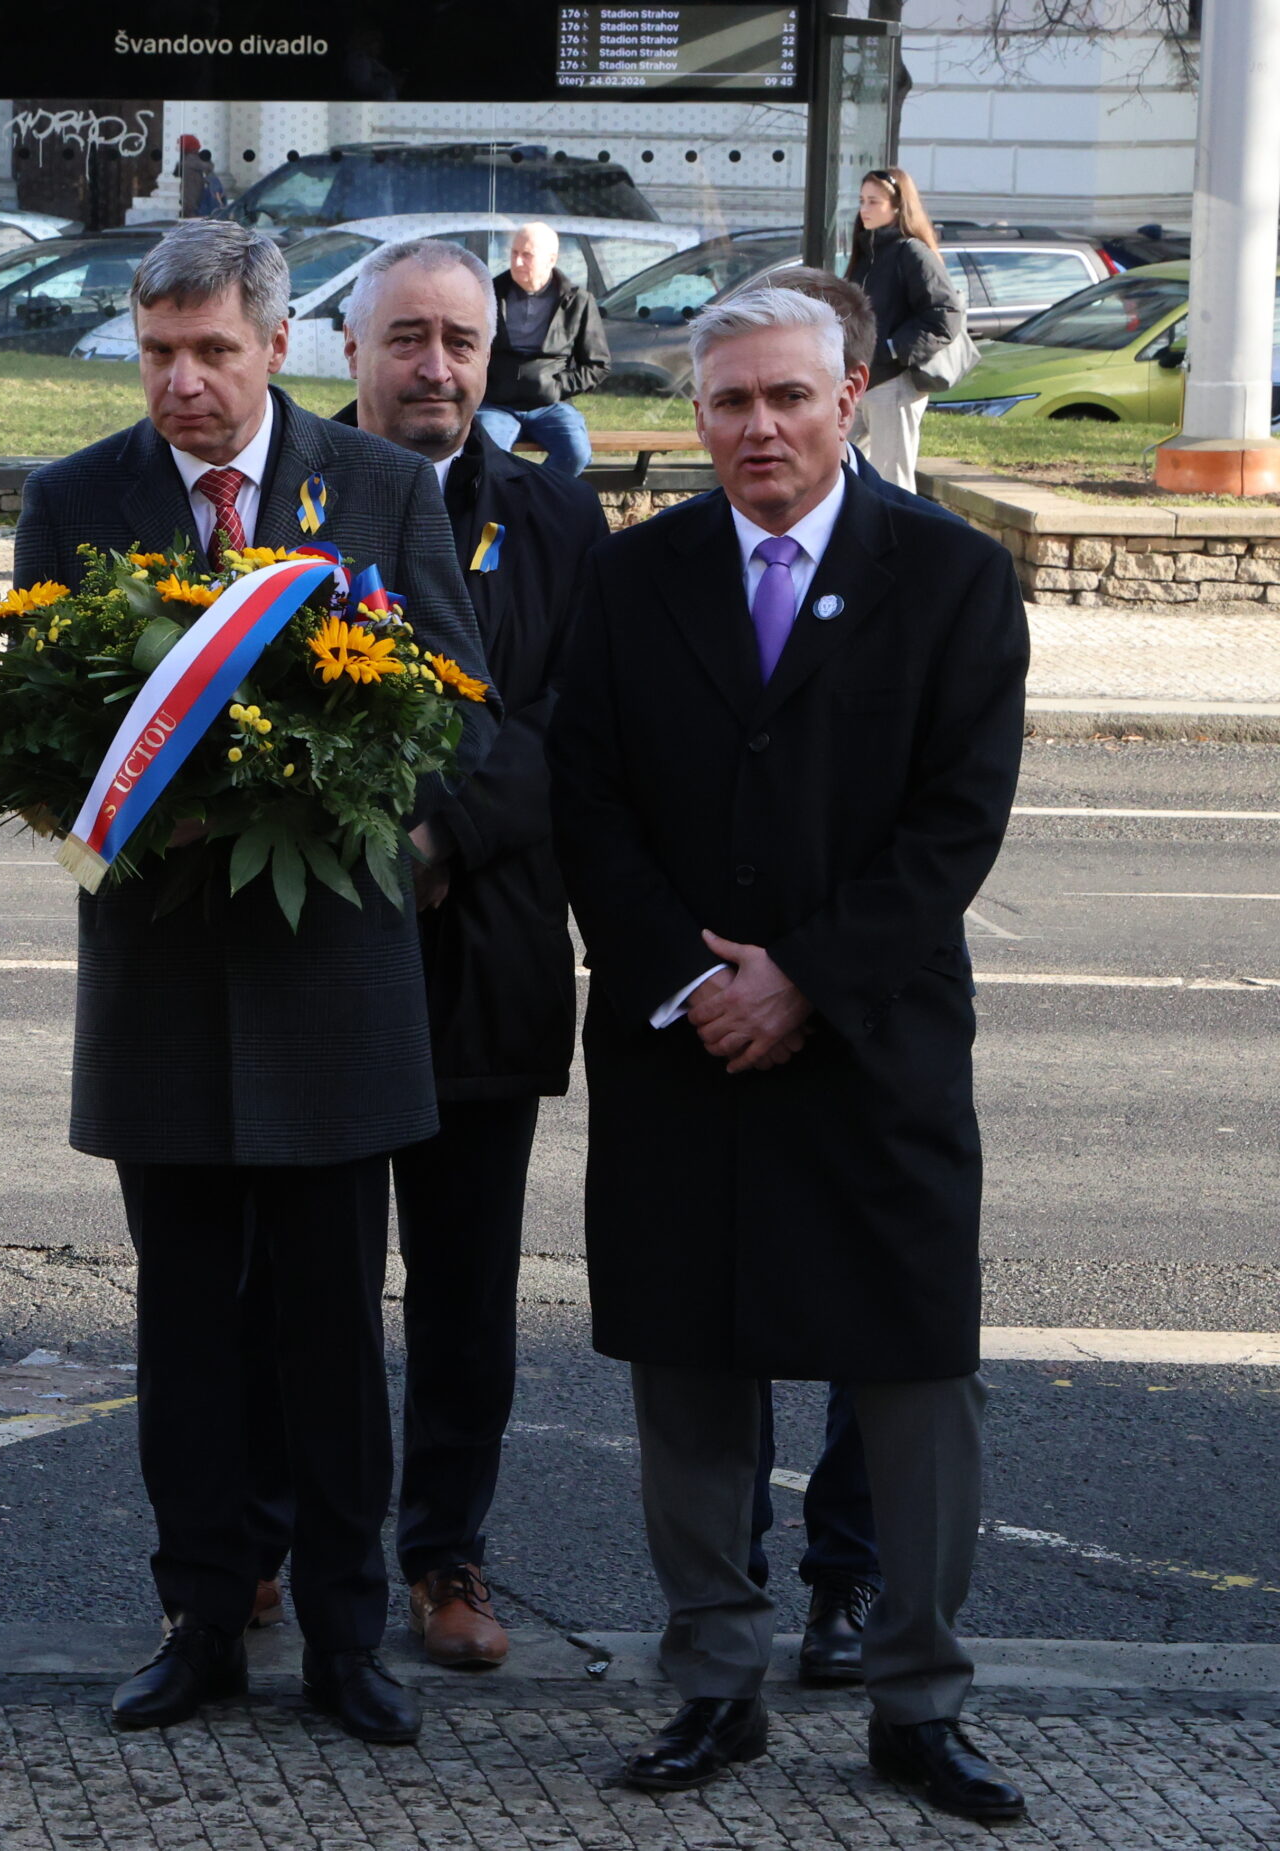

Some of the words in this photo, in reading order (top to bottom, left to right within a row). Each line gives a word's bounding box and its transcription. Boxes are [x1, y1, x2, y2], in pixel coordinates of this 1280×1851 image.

[561, 9, 580, 18] 176
[600, 9, 639, 18] Stadion
[640, 9, 680, 18] Strahov
[788, 10, 796, 19] 4
[561, 22, 580, 32] 176
[600, 22, 638, 32] Stadion
[640, 22, 680, 32] Strahov
[783, 23, 796, 32] 12
[114, 29, 233, 55] Švandovo
[239, 34, 329, 55] divadlo
[560, 35, 580, 44] 176
[600, 35, 638, 44] Stadion
[640, 35, 679, 44] Strahov
[782, 36, 794, 45] 22
[560, 48, 579, 57] 176
[599, 48, 638, 57] Stadion
[640, 48, 678, 57] Strahov
[782, 49, 794, 58] 34
[560, 61, 579, 70] 176
[598, 61, 637, 70] Stadion
[639, 61, 678, 70] Strahov
[780, 62, 794, 70] 46
[590, 77, 647, 86] 24.02.2026
[780, 77, 794, 86] 45
